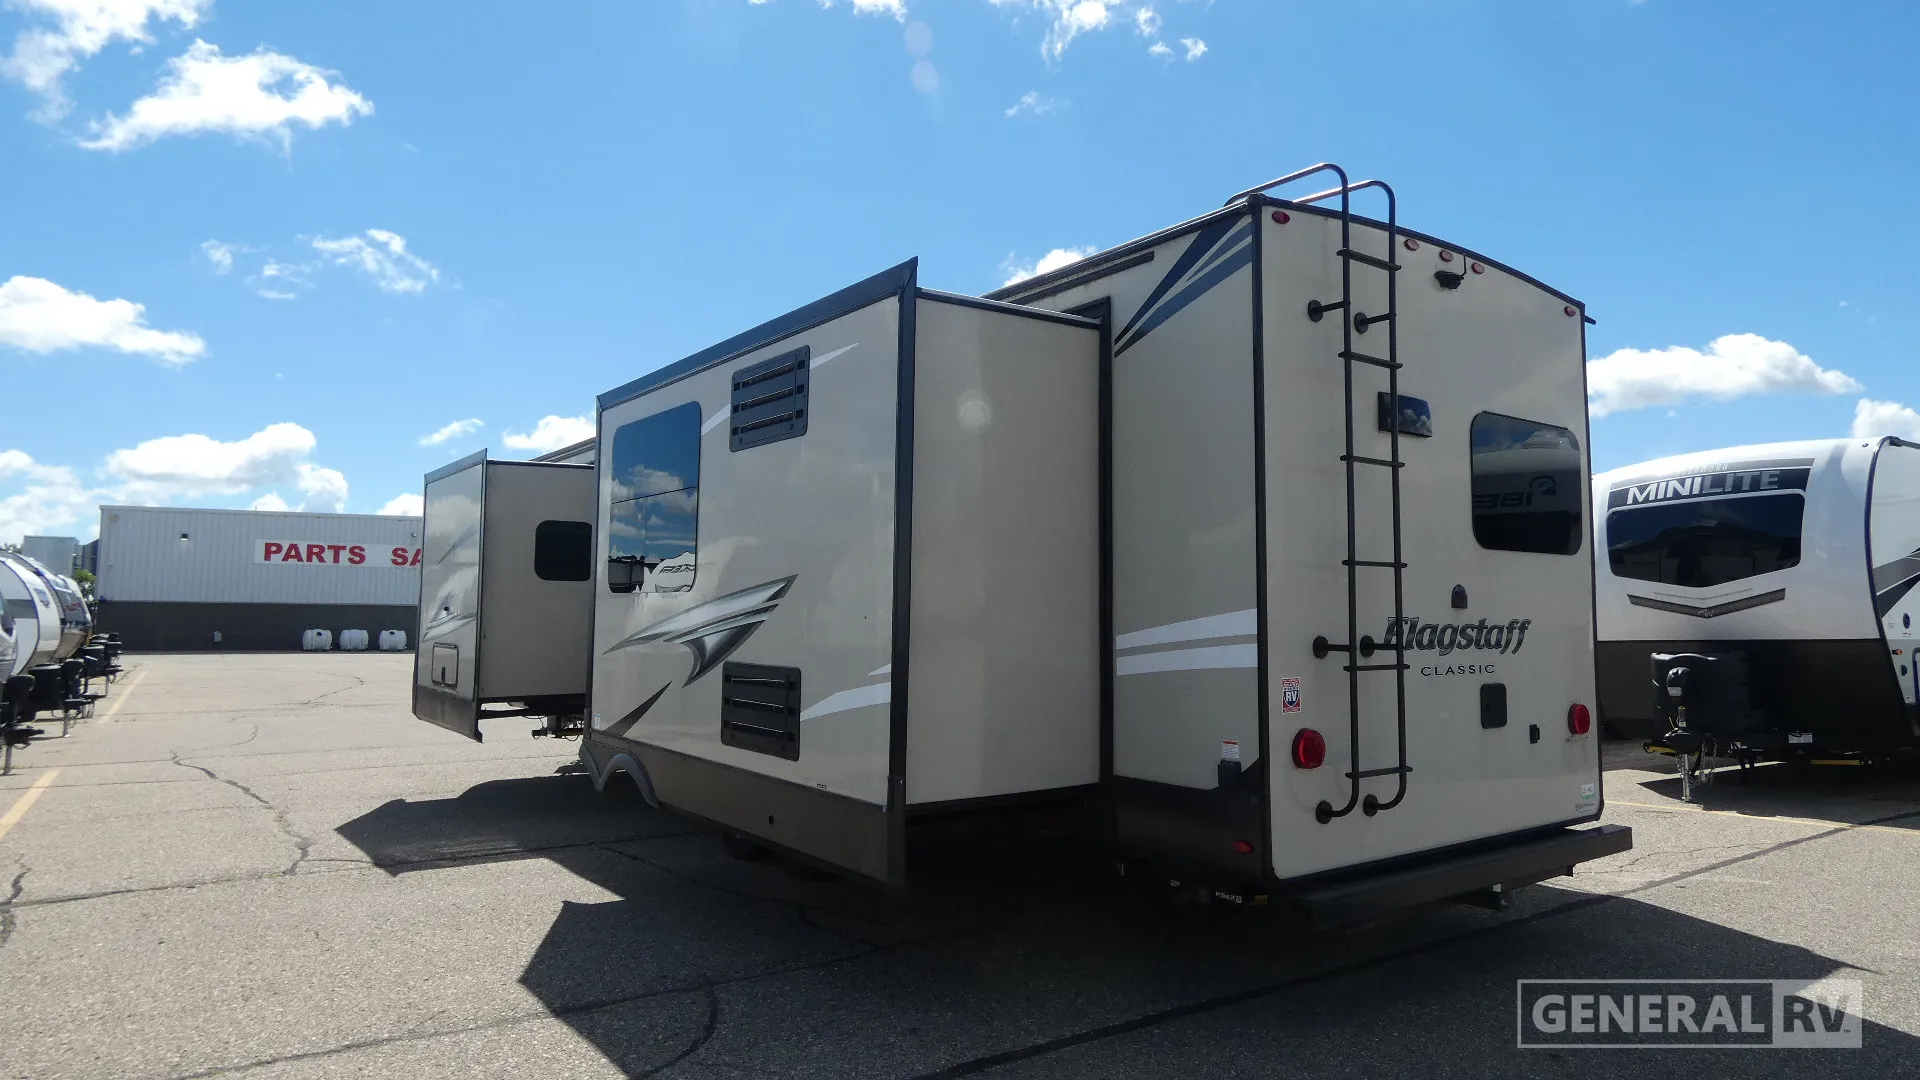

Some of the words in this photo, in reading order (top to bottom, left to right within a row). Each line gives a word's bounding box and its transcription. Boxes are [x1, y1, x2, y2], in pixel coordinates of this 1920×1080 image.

[1626, 470, 1781, 505] MINILITE
[264, 542, 366, 565] PARTS
[1383, 616, 1532, 656] Flagstaff
[1421, 664, 1495, 677] CLASSIC
[1285, 690, 1298, 702] RV
